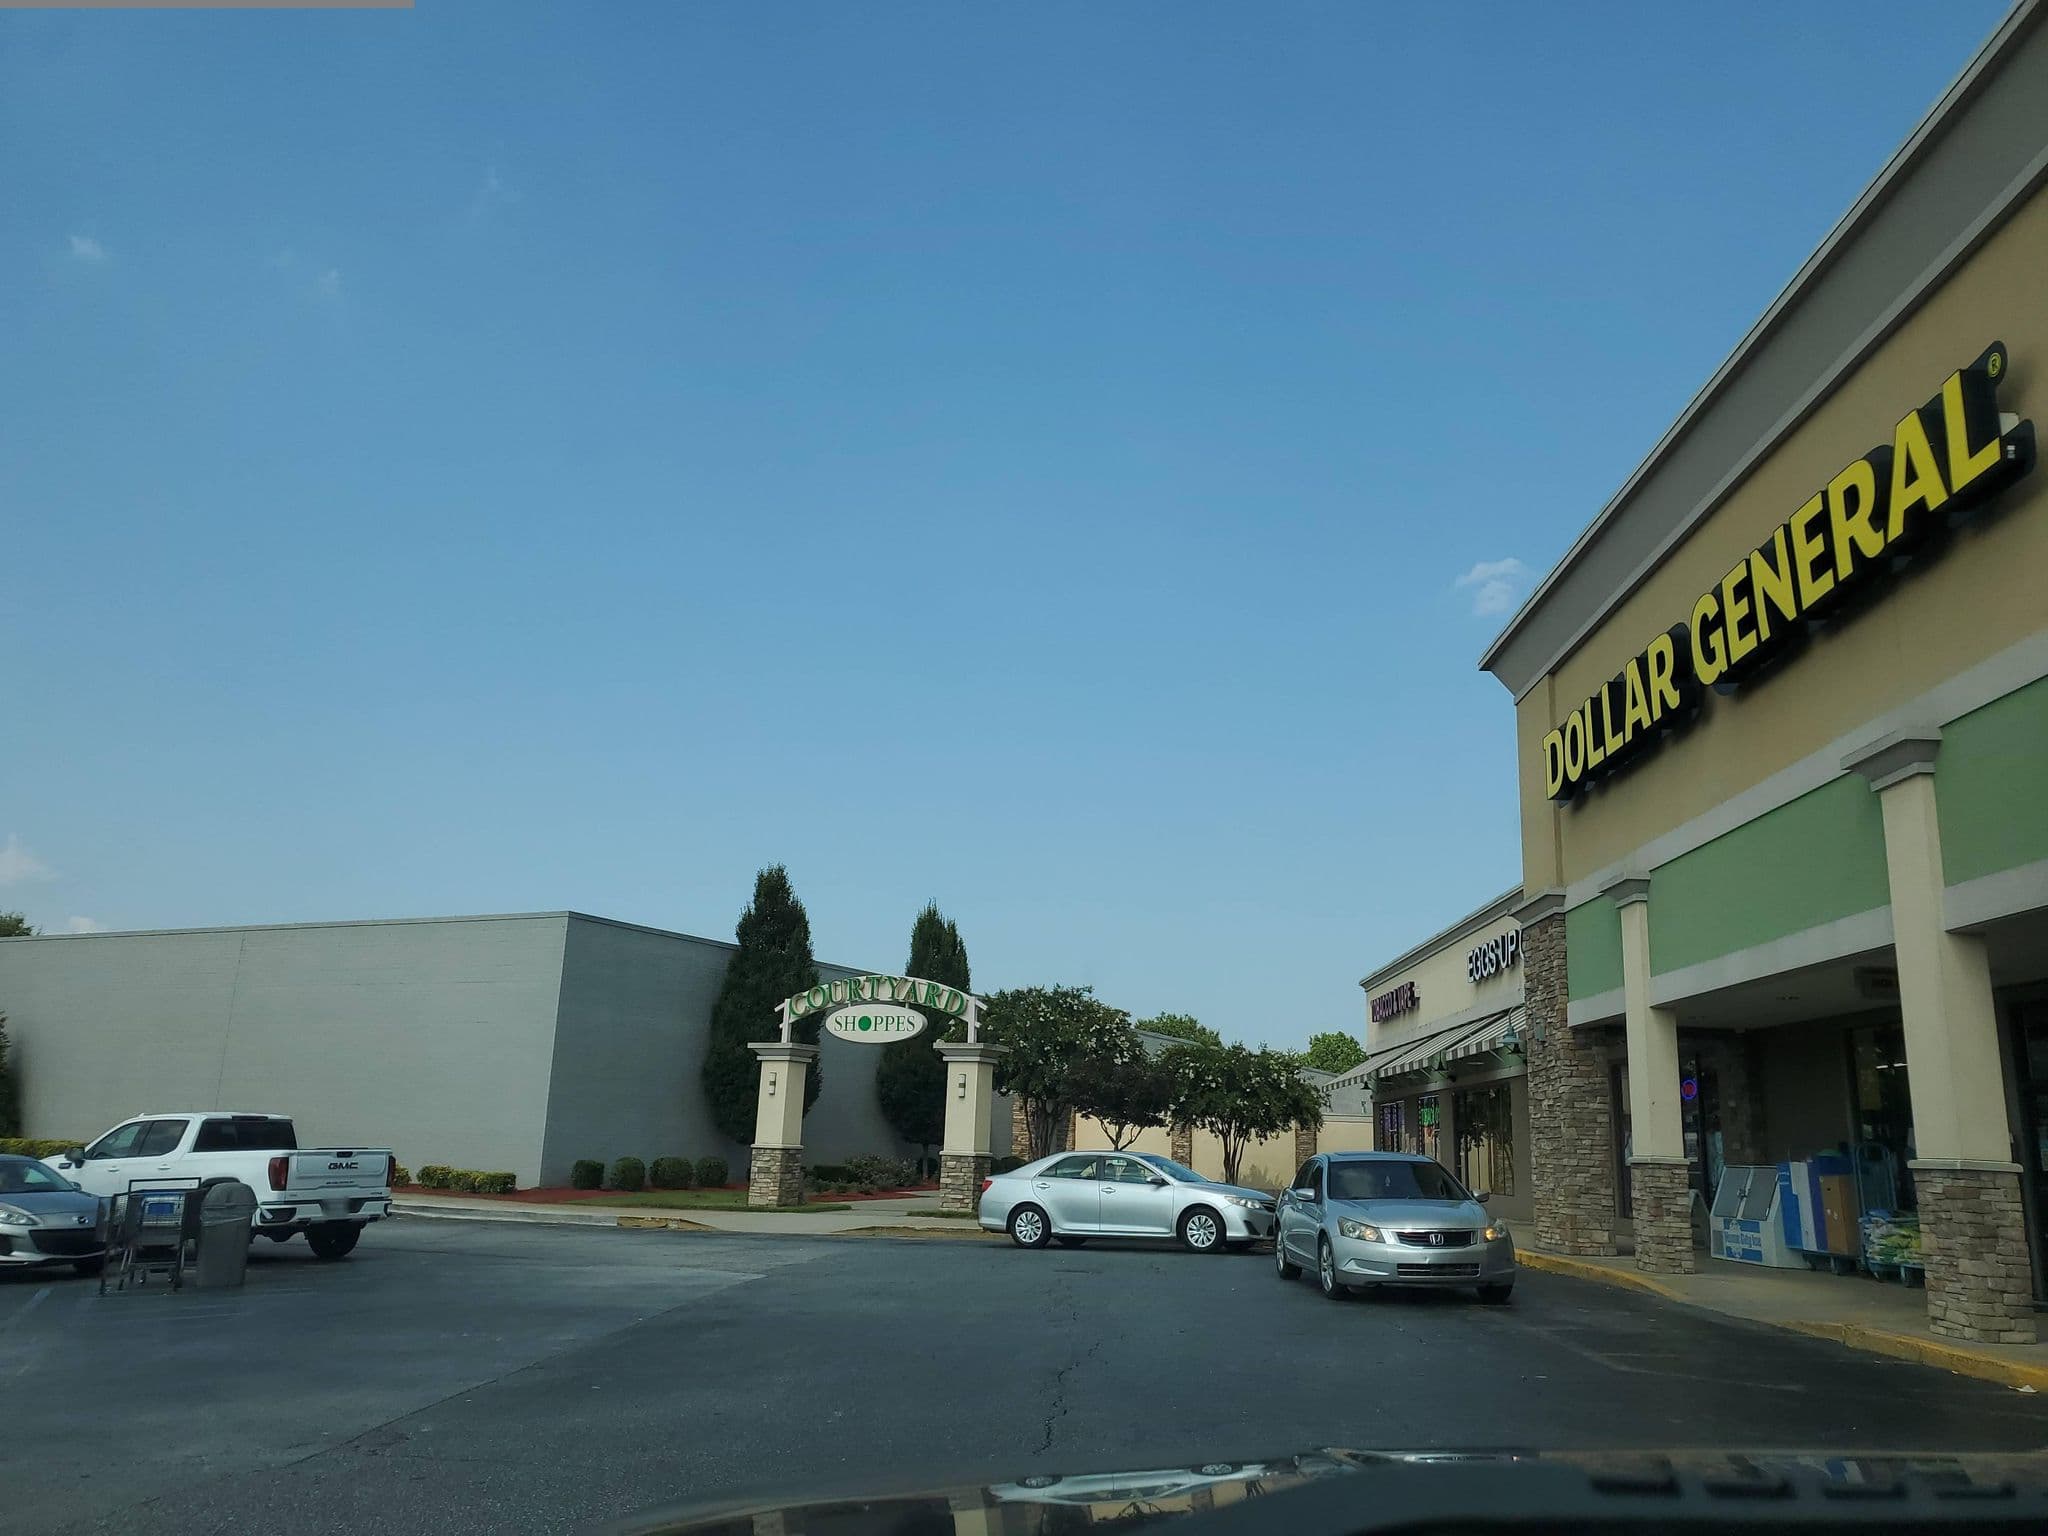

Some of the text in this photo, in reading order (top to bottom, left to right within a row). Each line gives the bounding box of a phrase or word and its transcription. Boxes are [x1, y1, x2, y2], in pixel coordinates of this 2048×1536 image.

[1543, 368, 2001, 800] DOLLAR GENERAL
[1467, 939, 1497, 983] EGGS
[1499, 930, 1517, 969] UP
[788, 975, 968, 1017] COURTYARD
[834, 1014, 915, 1032] SHOPPES
[328, 1162, 359, 1170] GMC
